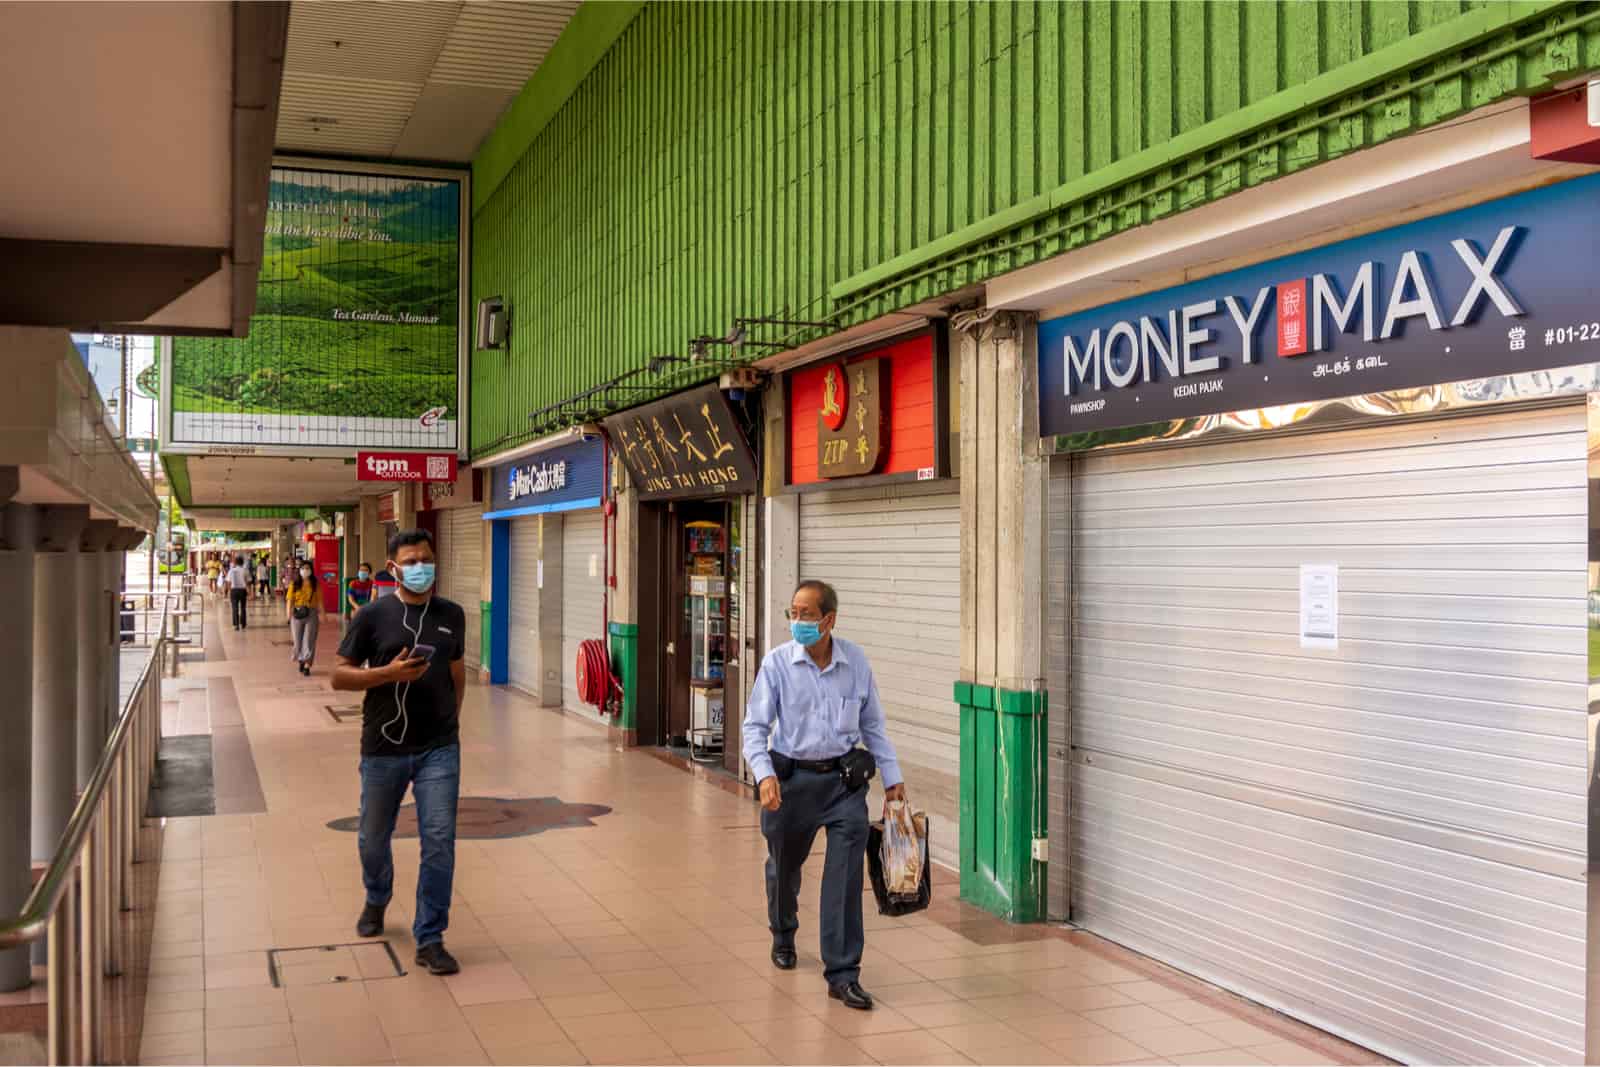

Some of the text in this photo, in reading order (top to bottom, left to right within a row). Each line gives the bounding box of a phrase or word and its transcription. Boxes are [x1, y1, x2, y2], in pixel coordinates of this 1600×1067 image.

[268, 199, 337, 215] ncredible
[1312, 225, 1522, 351] MAX
[1063, 285, 1276, 396] MONEY
[1508, 325, 1526, 351] 當
[1173, 378, 1225, 399] KEDAI PAJAK
[1069, 399, 1106, 416] PAWNSHOP
[365, 455, 408, 475] tpm
[823, 439, 848, 465] ZTP
[647, 465, 738, 492] JING TAI HONG
